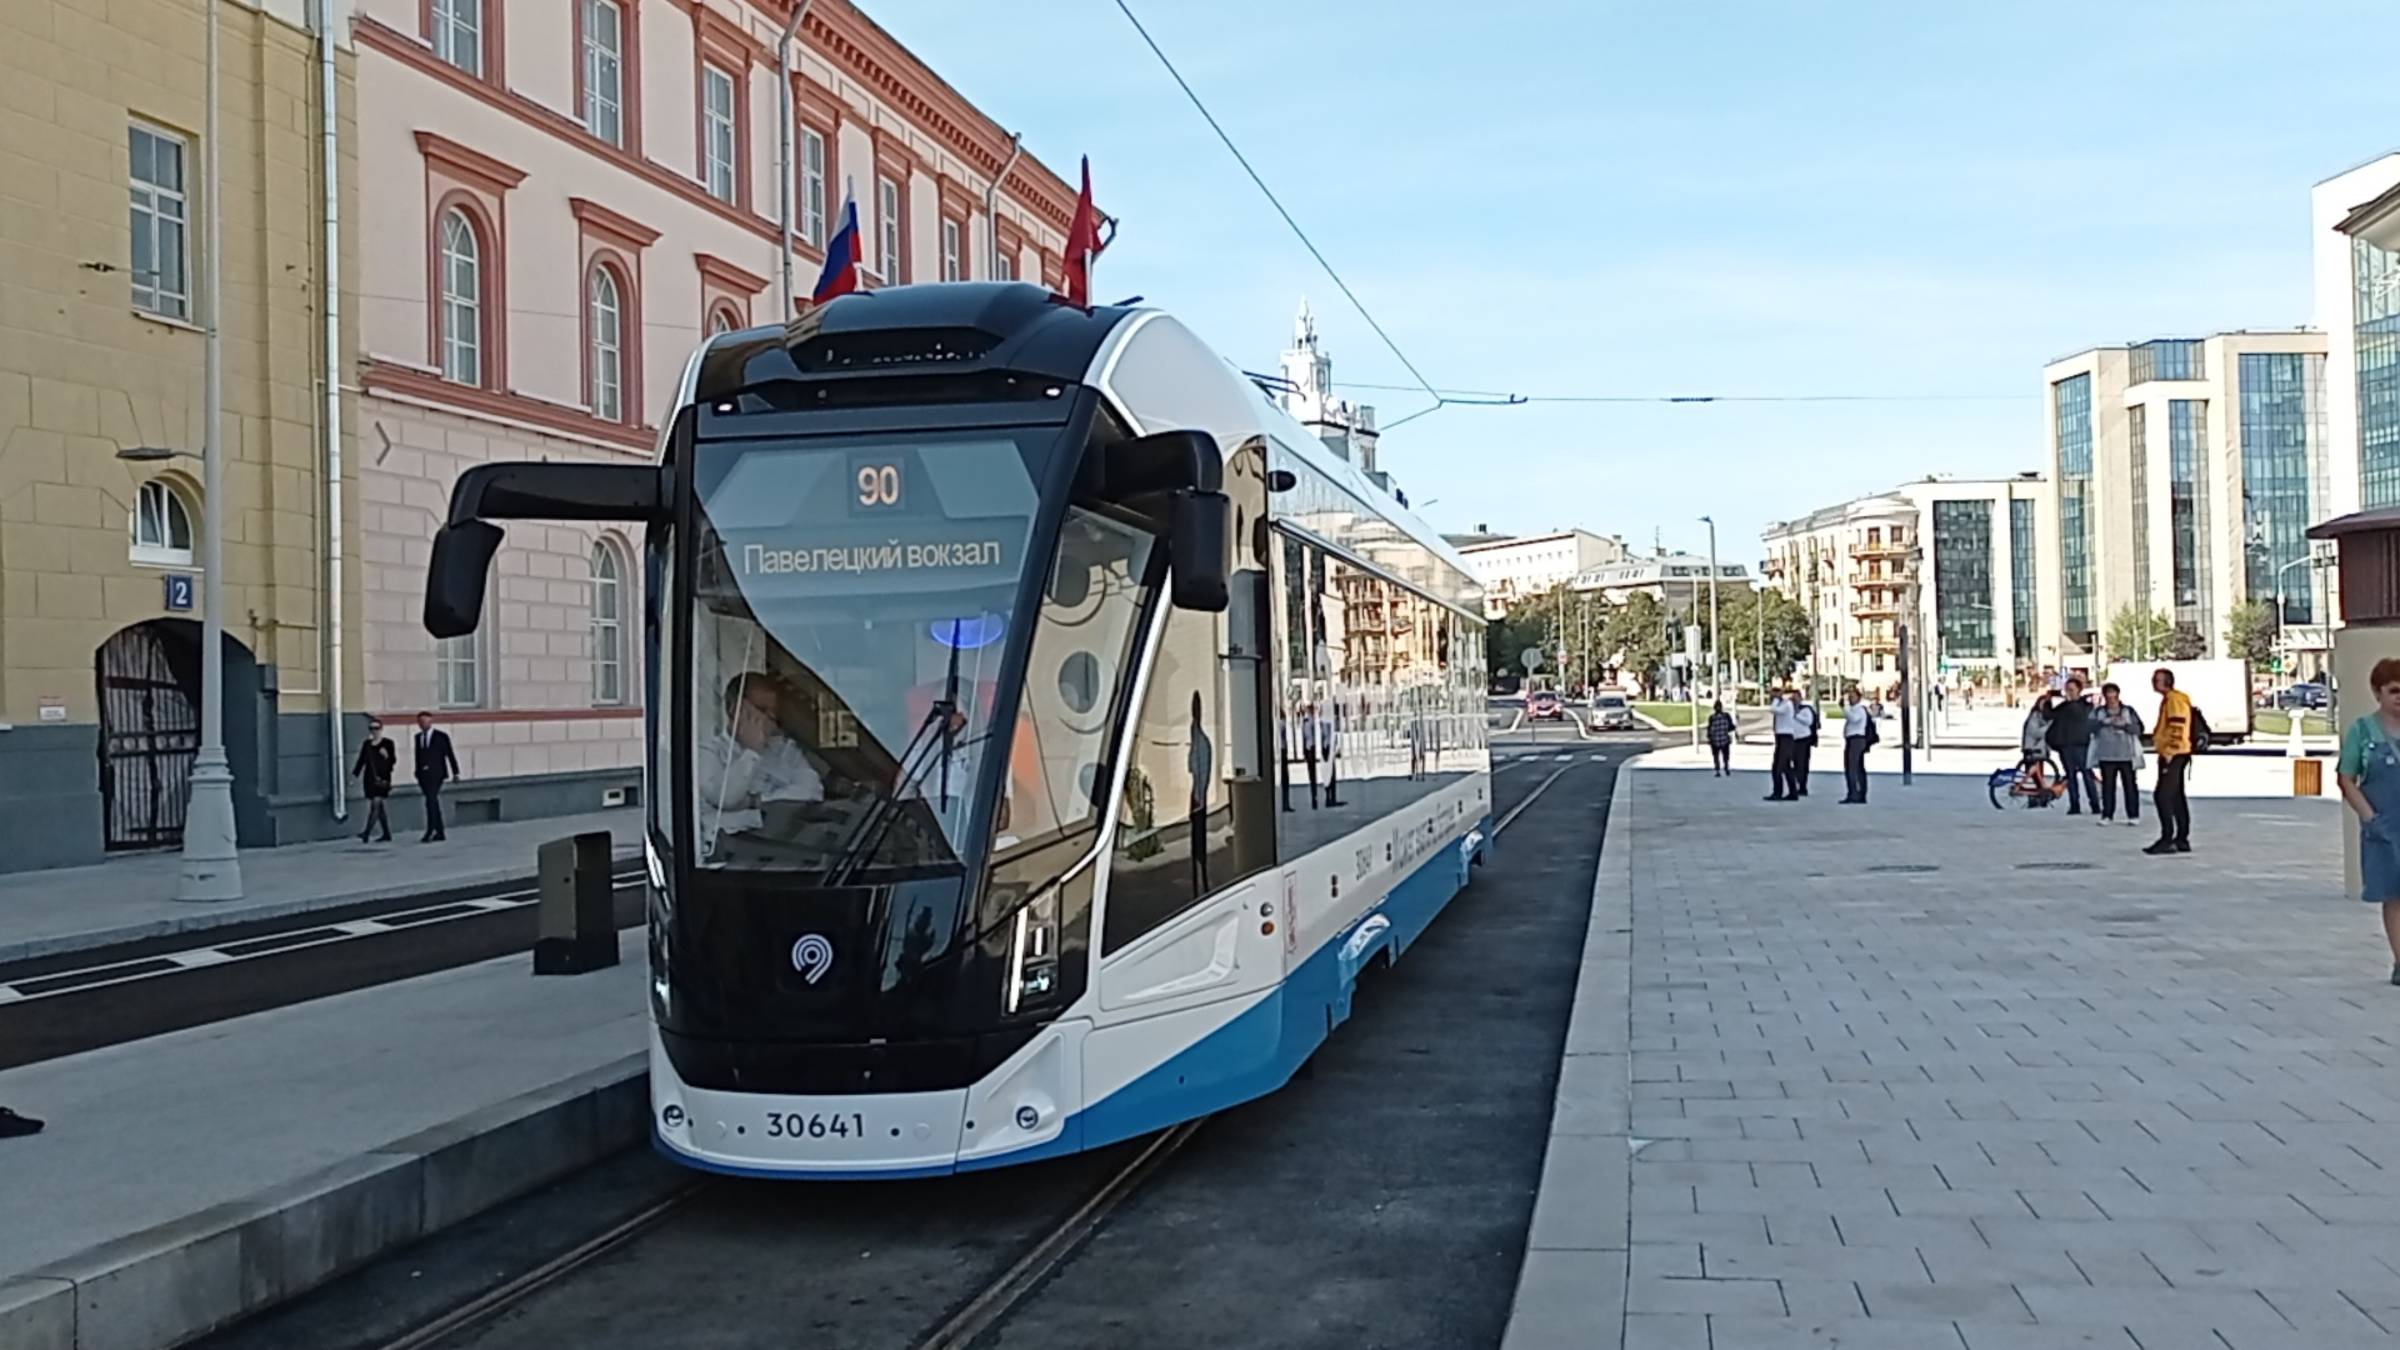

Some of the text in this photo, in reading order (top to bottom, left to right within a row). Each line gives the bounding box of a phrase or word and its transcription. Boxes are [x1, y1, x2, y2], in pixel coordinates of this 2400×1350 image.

[857, 465, 901, 507] 90
[743, 539, 1001, 575] Павелецкий вокзал
[175, 581, 188, 605] 2
[766, 1112, 863, 1139] 30641
